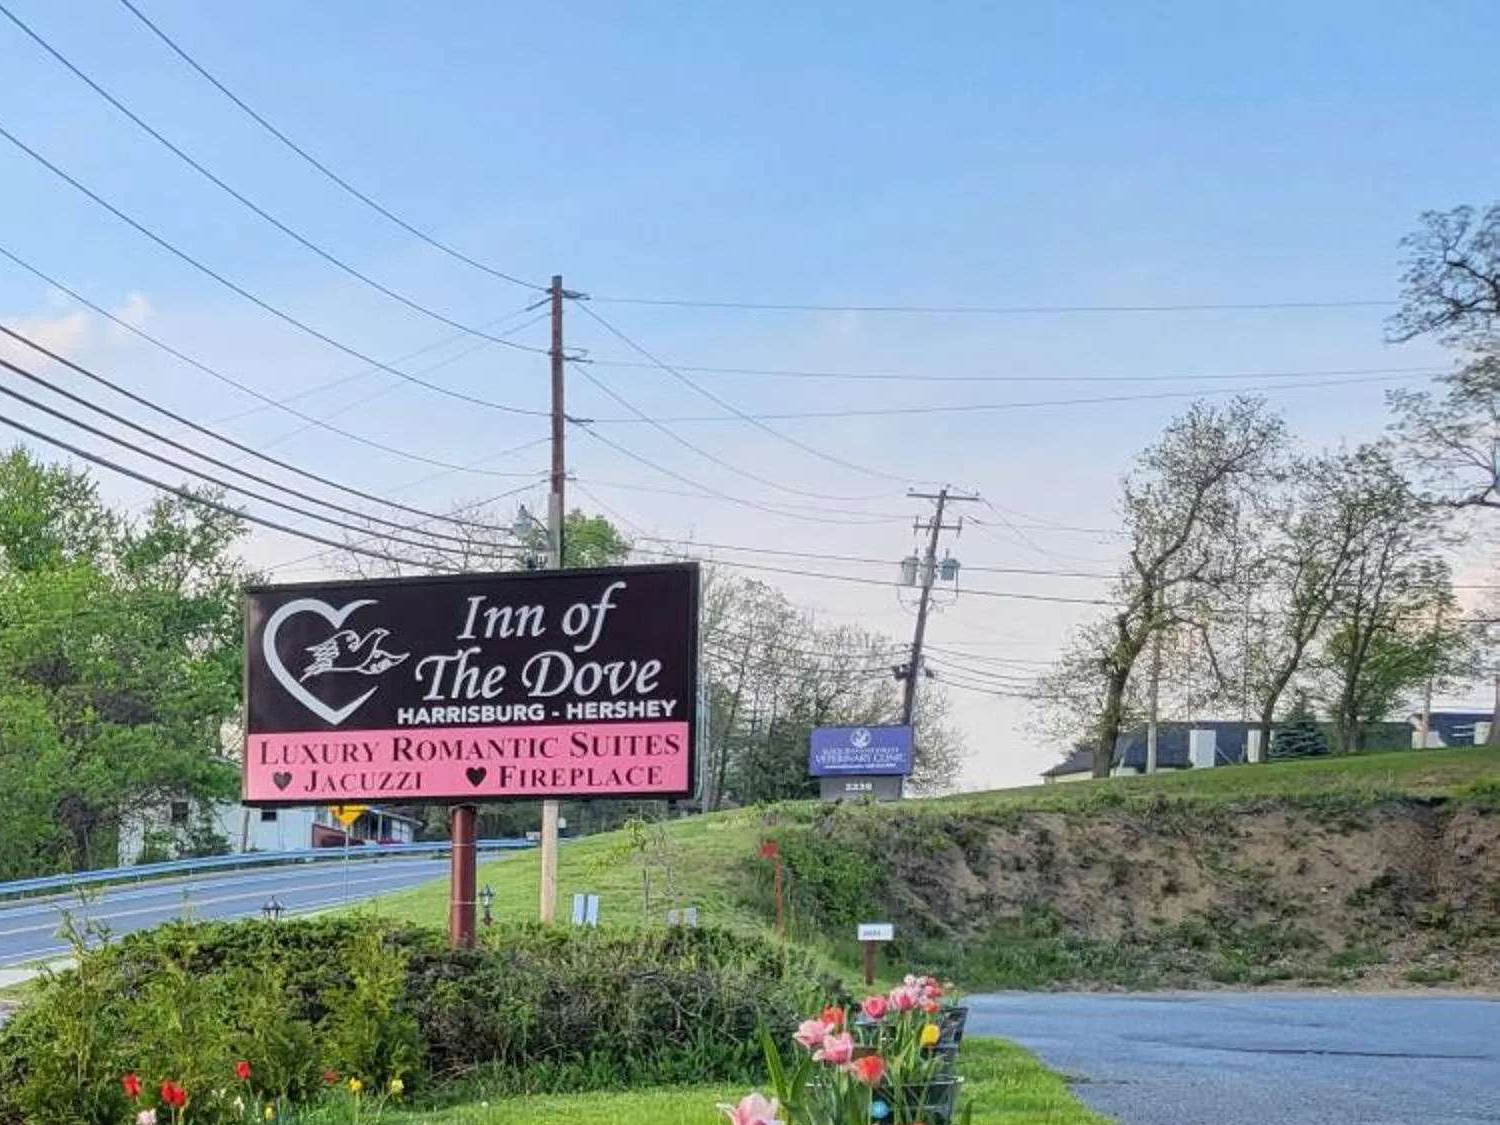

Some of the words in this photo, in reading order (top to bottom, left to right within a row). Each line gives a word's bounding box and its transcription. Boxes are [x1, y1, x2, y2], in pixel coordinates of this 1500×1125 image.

[457, 595, 546, 639] Inn
[562, 581, 627, 653] of
[415, 646, 506, 701] The
[521, 650, 662, 698] Dove
[398, 704, 545, 725] HARRISBURG
[566, 700, 677, 720] HERSHEY
[261, 739, 380, 765] LUXURY
[392, 735, 559, 762] ROMANTIC
[569, 731, 680, 759] SUITES
[304, 770, 422, 793] JACUZZI
[499, 765, 663, 788] FIREPLACE
